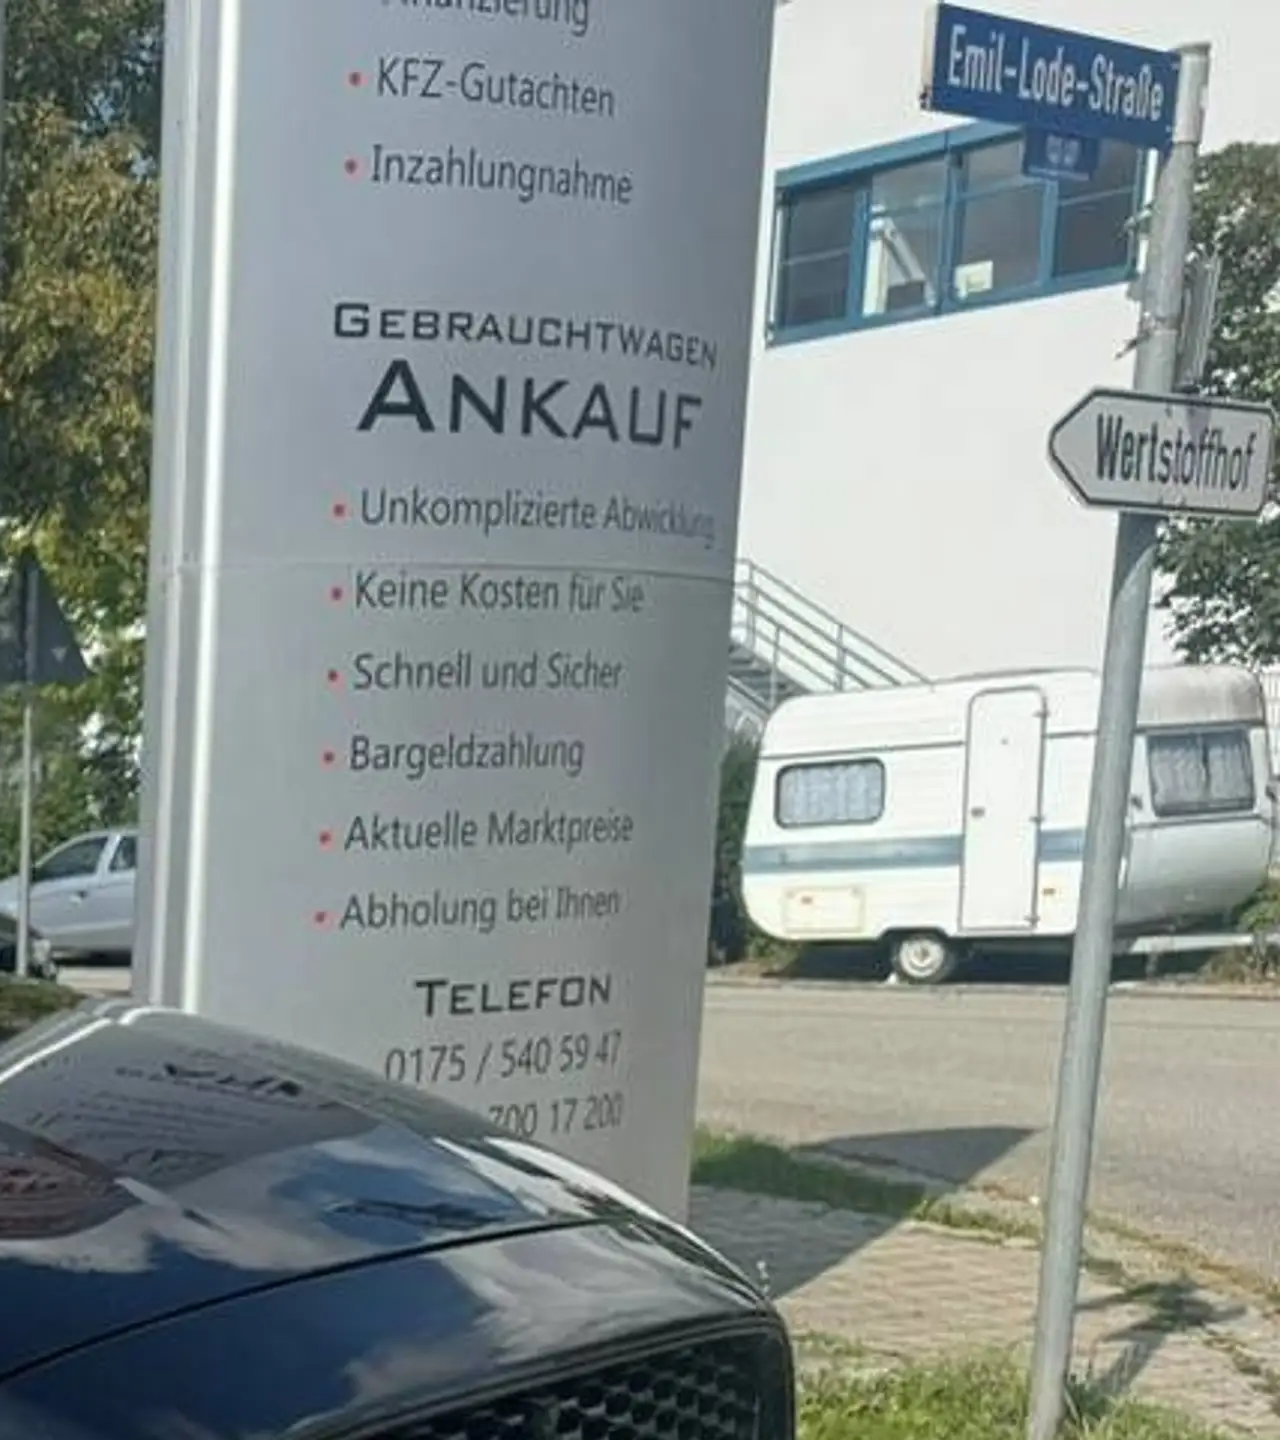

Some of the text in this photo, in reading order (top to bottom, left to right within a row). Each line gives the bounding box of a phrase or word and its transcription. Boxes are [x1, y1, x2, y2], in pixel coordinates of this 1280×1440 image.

[377, 57, 615, 117] KFZ-Gutachten
[947, 24, 1164, 121] Emil-Lode-Straße
[371, 144, 633, 204] Inzahlungnahme
[335, 303, 718, 370] GEBRAUCHTWAGEN
[356, 359, 703, 449] ANKAUF
[1097, 414, 1257, 491] Wertstoffhof
[361, 486, 596, 537] Unkomplizierte
[356, 570, 646, 612] Keine Kosten für Sie
[354, 650, 623, 690] Schnell und Sicher
[350, 732, 585, 781] Bargeldzahlung
[344, 807, 634, 854] Aktuelle Marktpreise
[340, 886, 621, 934] Abholung bei Ihnen
[415, 975, 612, 1018] TELEFON
[385, 1044, 465, 1082] 0175
[501, 1037, 552, 1078] 540
[560, 1032, 589, 1073] 59
[550, 1098, 578, 1134] 17
